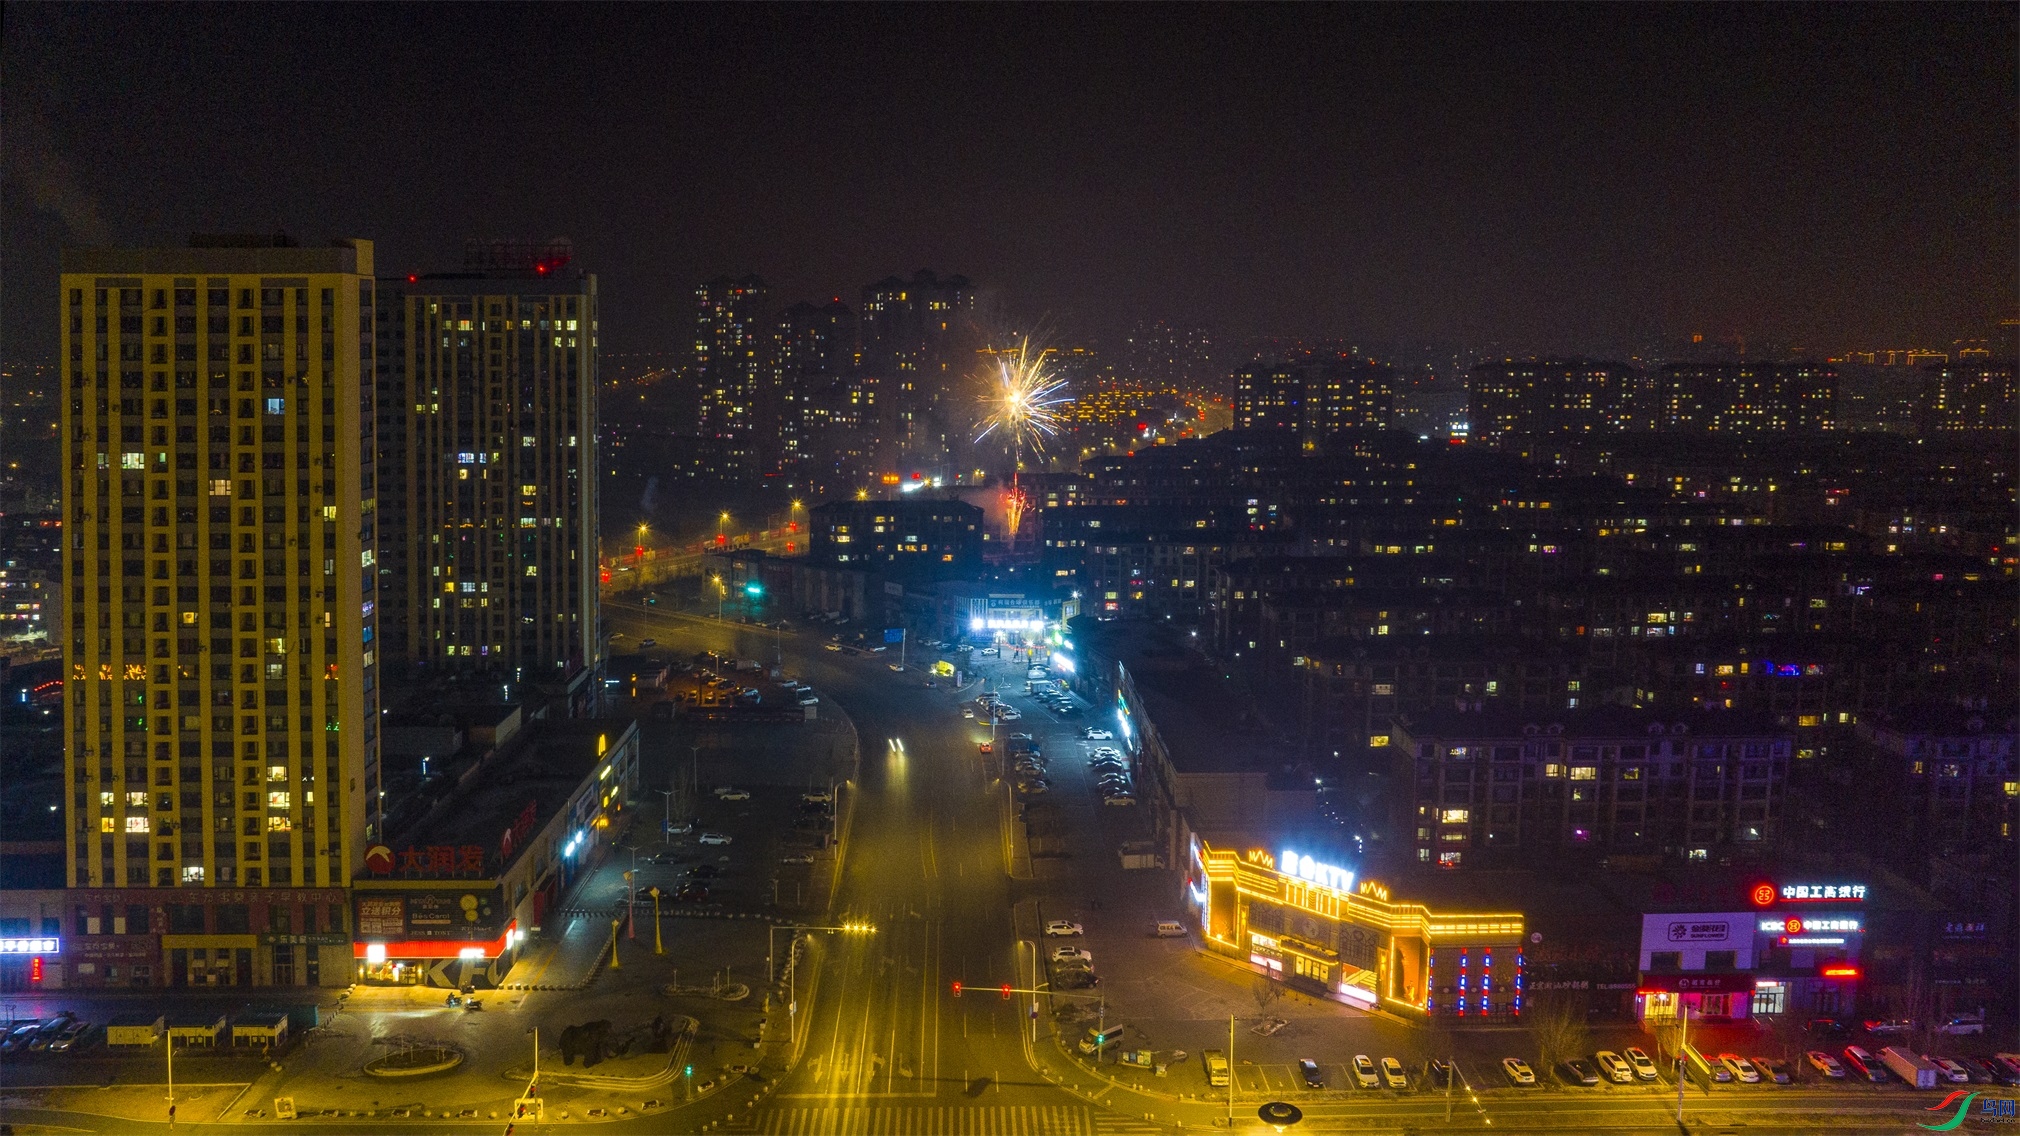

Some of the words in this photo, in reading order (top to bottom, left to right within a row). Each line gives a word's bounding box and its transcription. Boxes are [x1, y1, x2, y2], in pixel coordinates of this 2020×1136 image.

[400, 845, 484, 873] 大润发
[1783, 885, 1866, 898] 中国工商银行
